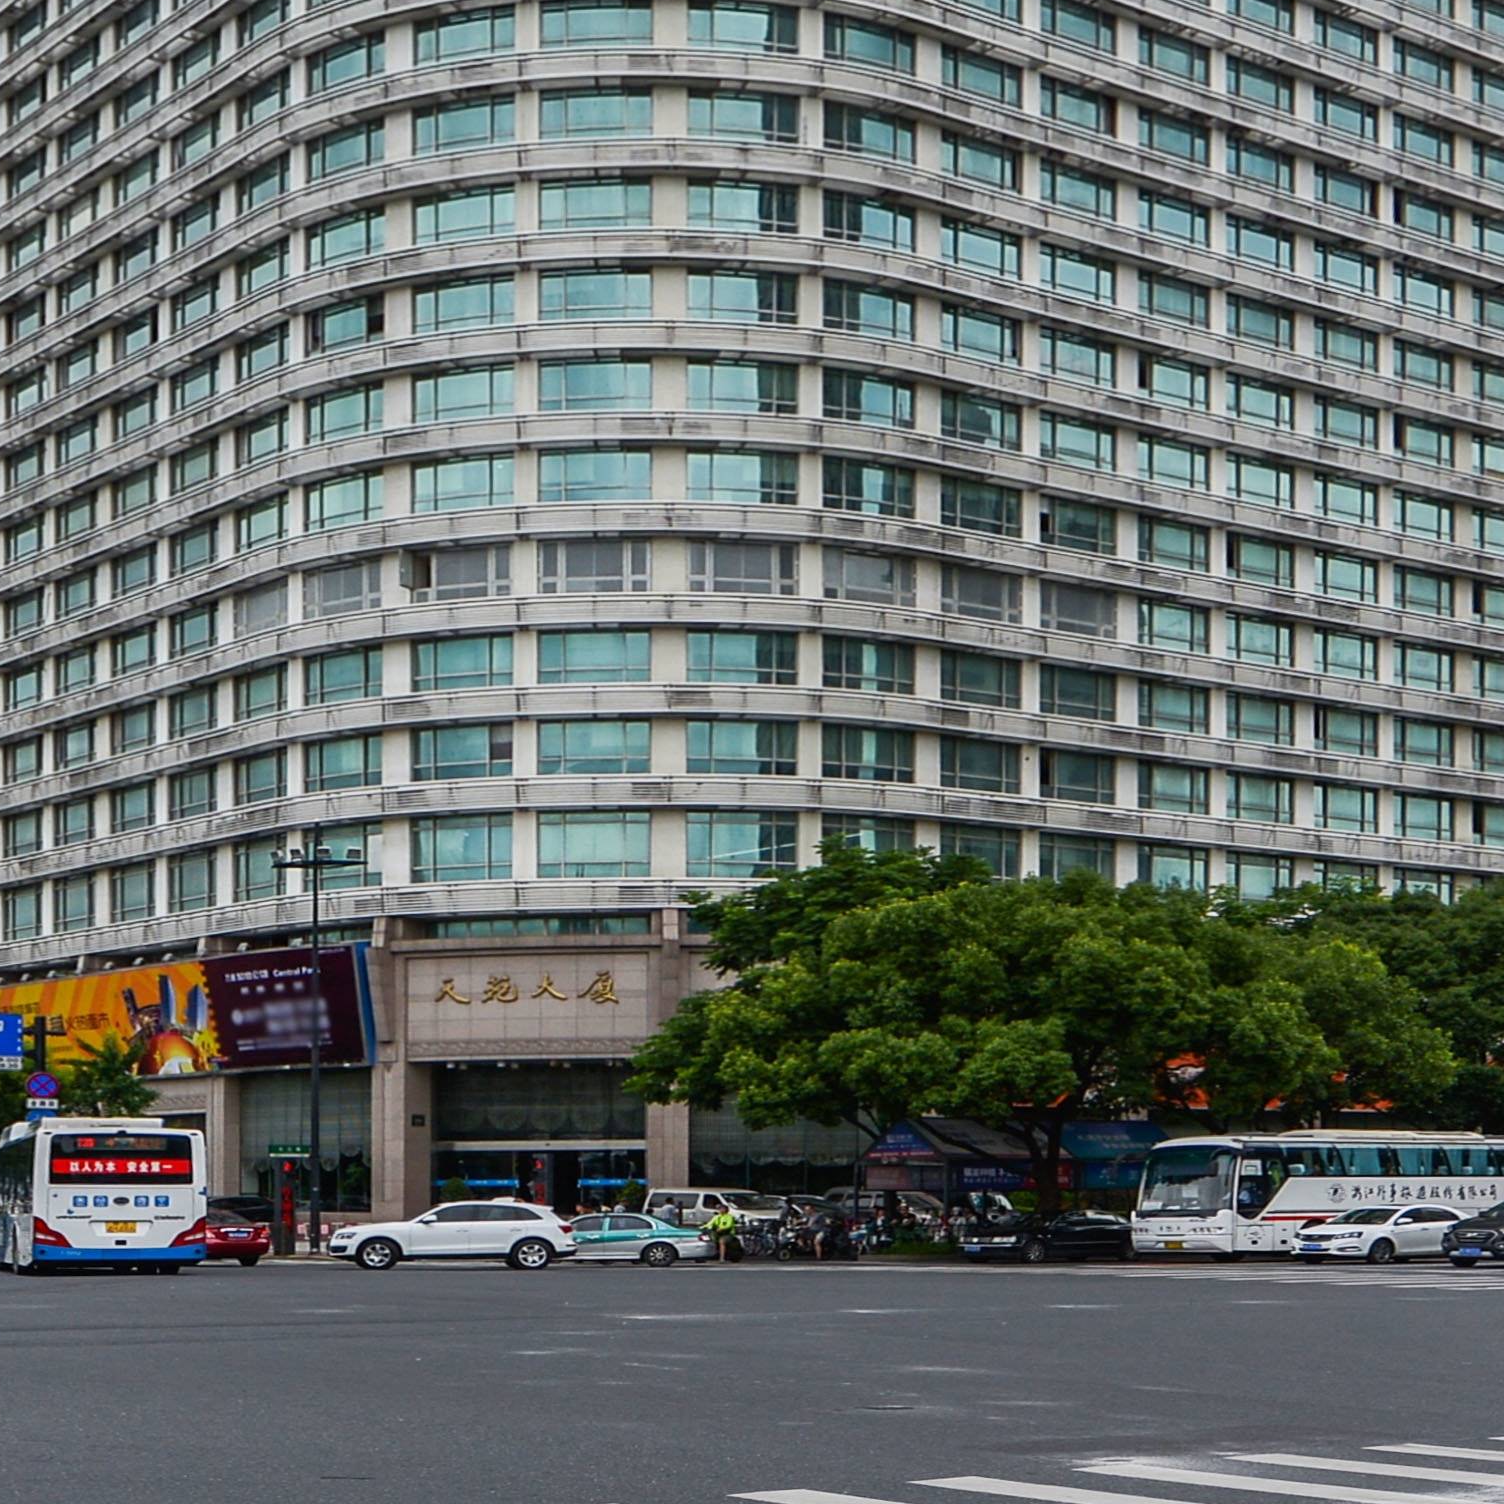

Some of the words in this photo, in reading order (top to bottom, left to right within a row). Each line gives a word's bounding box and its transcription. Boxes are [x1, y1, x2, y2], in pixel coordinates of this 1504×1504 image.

[273, 967, 299, 977] Central
[434, 970, 620, 1005] 天苑大厦
[69, 1161, 117, 1173] 以人为本
[126, 1161, 173, 1173] 安全第一
